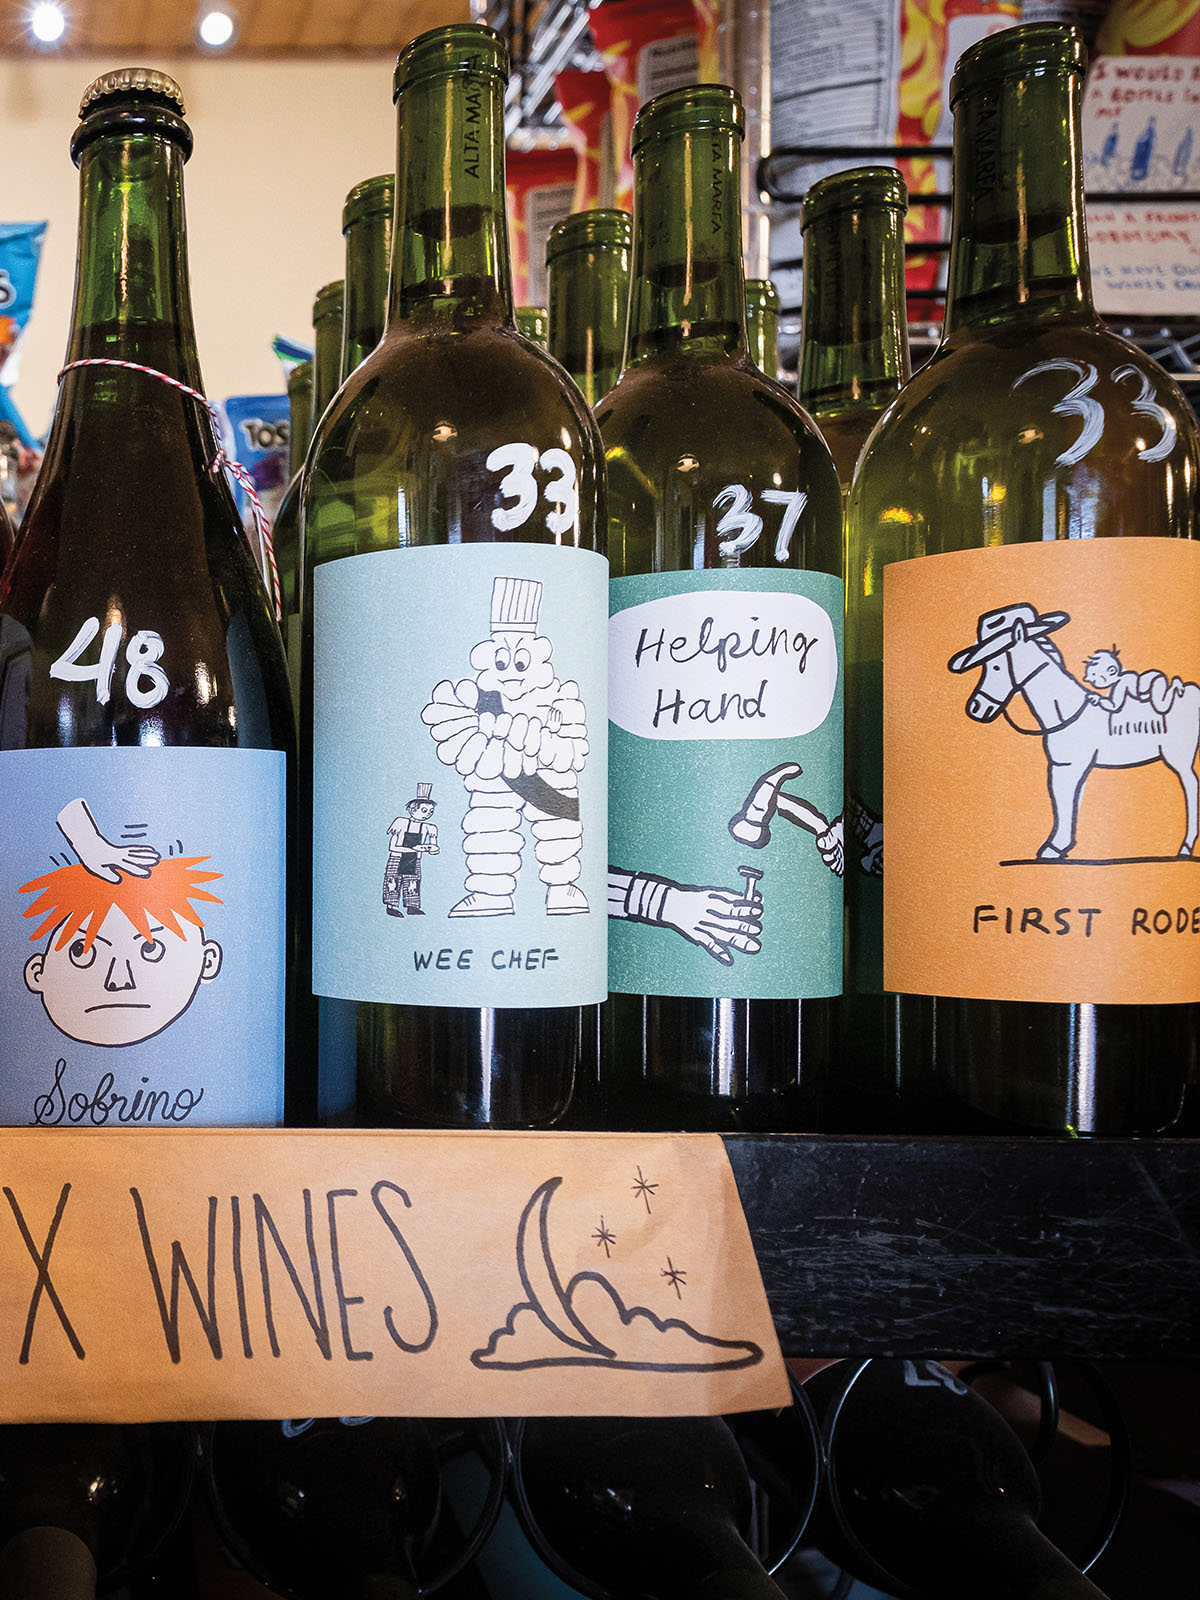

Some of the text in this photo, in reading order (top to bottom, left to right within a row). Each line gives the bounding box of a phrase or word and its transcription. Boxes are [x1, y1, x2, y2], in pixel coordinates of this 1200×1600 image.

[464, 129, 480, 179] ALTA
[1011, 356, 1179, 468] 33
[486, 443, 578, 534] 33
[714, 484, 808, 563] 37
[49, 615, 171, 710] 48
[636, 616, 820, 674] Helping
[653, 679, 769, 727] Hand
[973, 904, 1101, 938] FIRST
[413, 948, 560, 971] WEE CHEF
[30, 1058, 203, 1125] Sobrino
[130, 1179, 439, 1365] WINES
